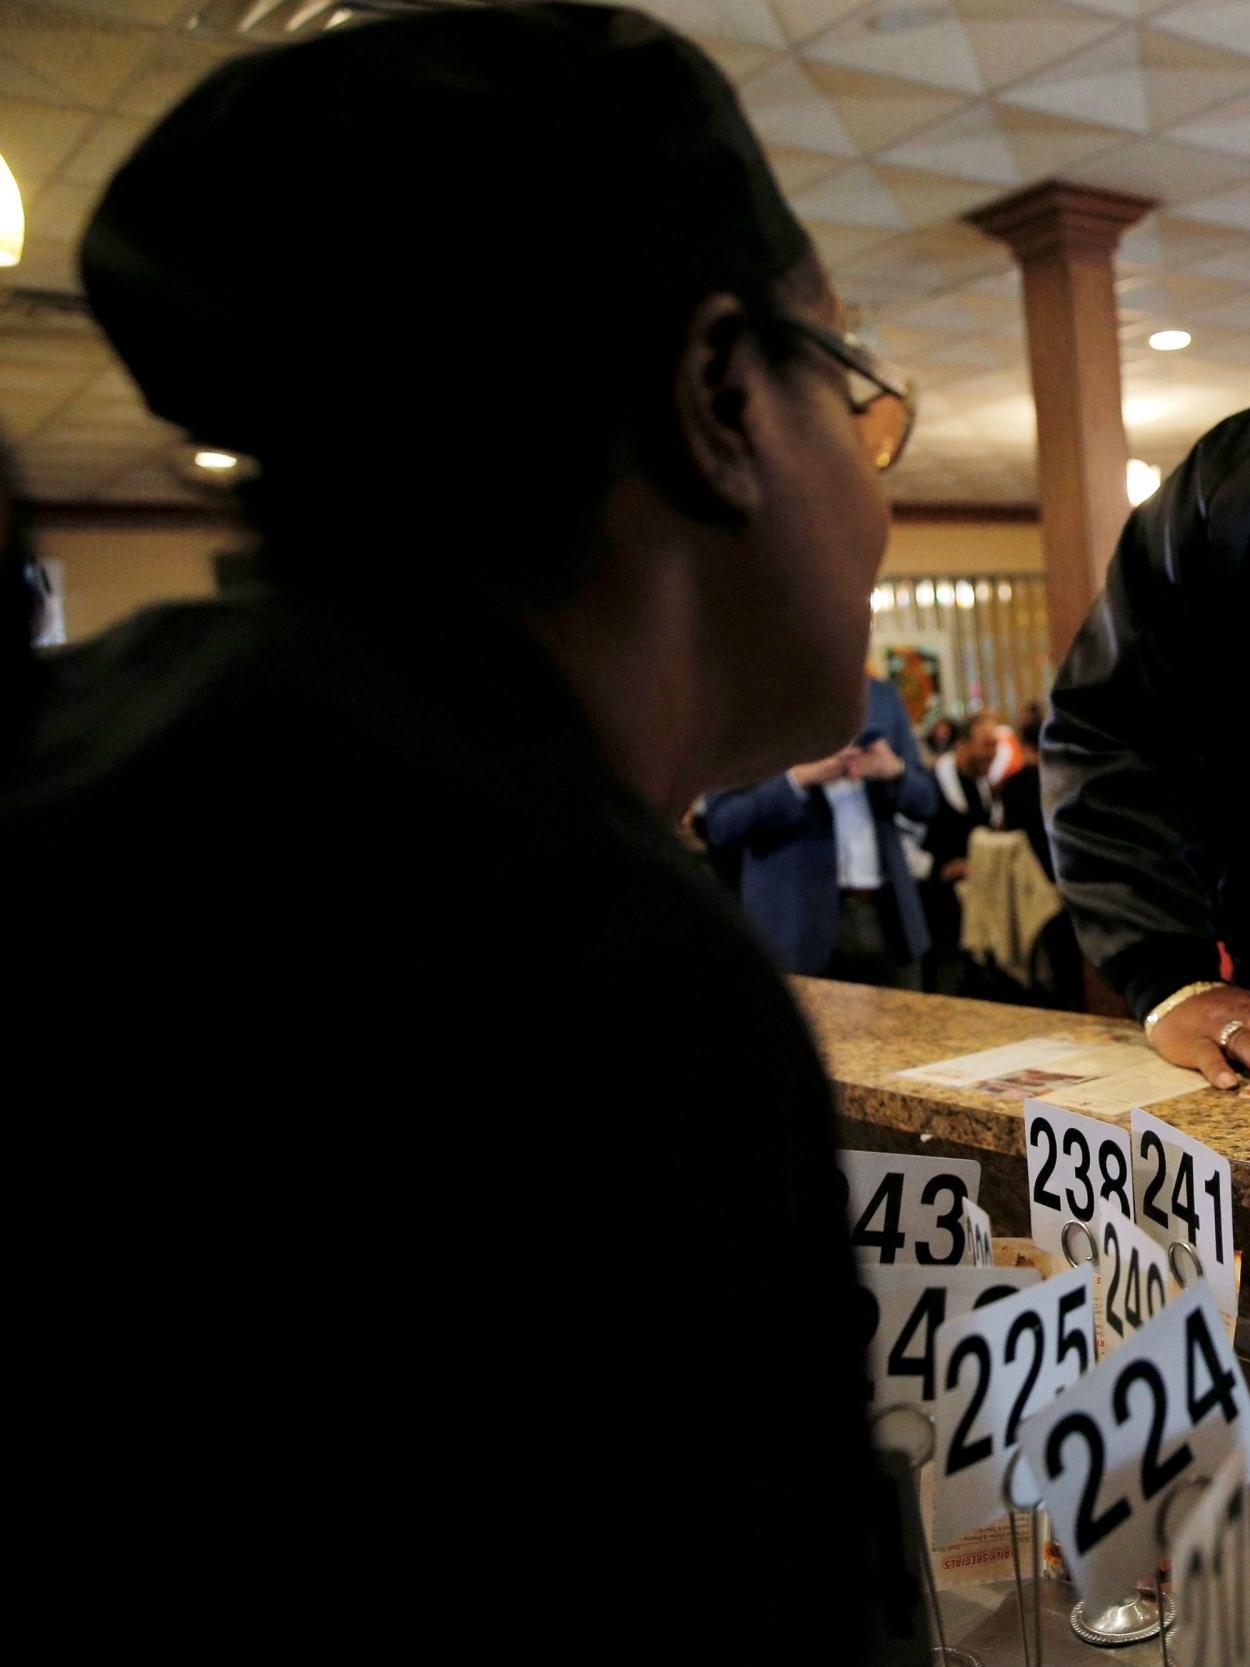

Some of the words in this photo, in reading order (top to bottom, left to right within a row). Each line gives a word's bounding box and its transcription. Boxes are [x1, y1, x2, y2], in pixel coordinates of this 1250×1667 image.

[838, 1169, 968, 1265] 43
[1029, 1116, 1131, 1223] 238
[1139, 1129, 1224, 1265] 241
[945, 1285, 1089, 1477] 225
[1045, 1304, 1239, 1557] 224
[944, 1552, 988, 1570] SPECIALS
